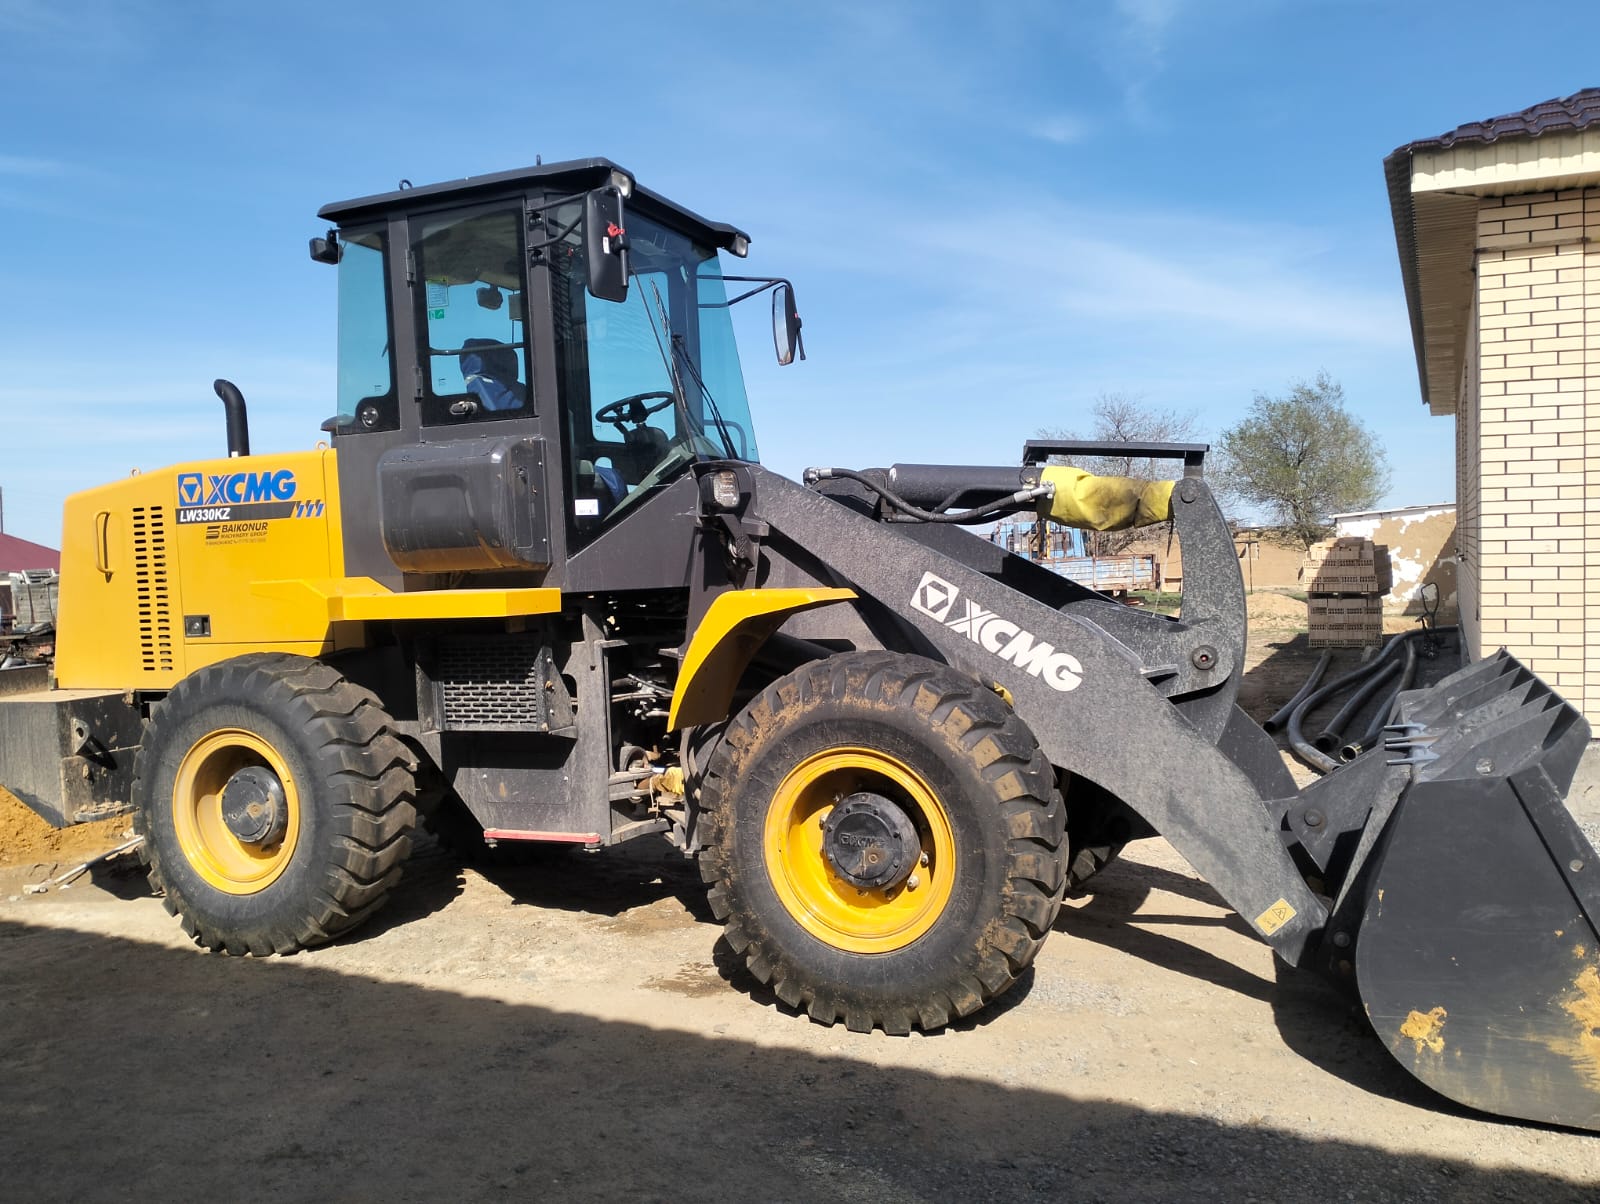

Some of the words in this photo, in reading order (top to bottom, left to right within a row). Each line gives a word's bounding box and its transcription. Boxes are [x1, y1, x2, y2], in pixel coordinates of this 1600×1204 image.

[205, 469, 297, 505] XCMG
[180, 508, 231, 522] LW330KZ
[221, 522, 268, 533] BAIKONUR
[945, 598, 1083, 692] XCMG
